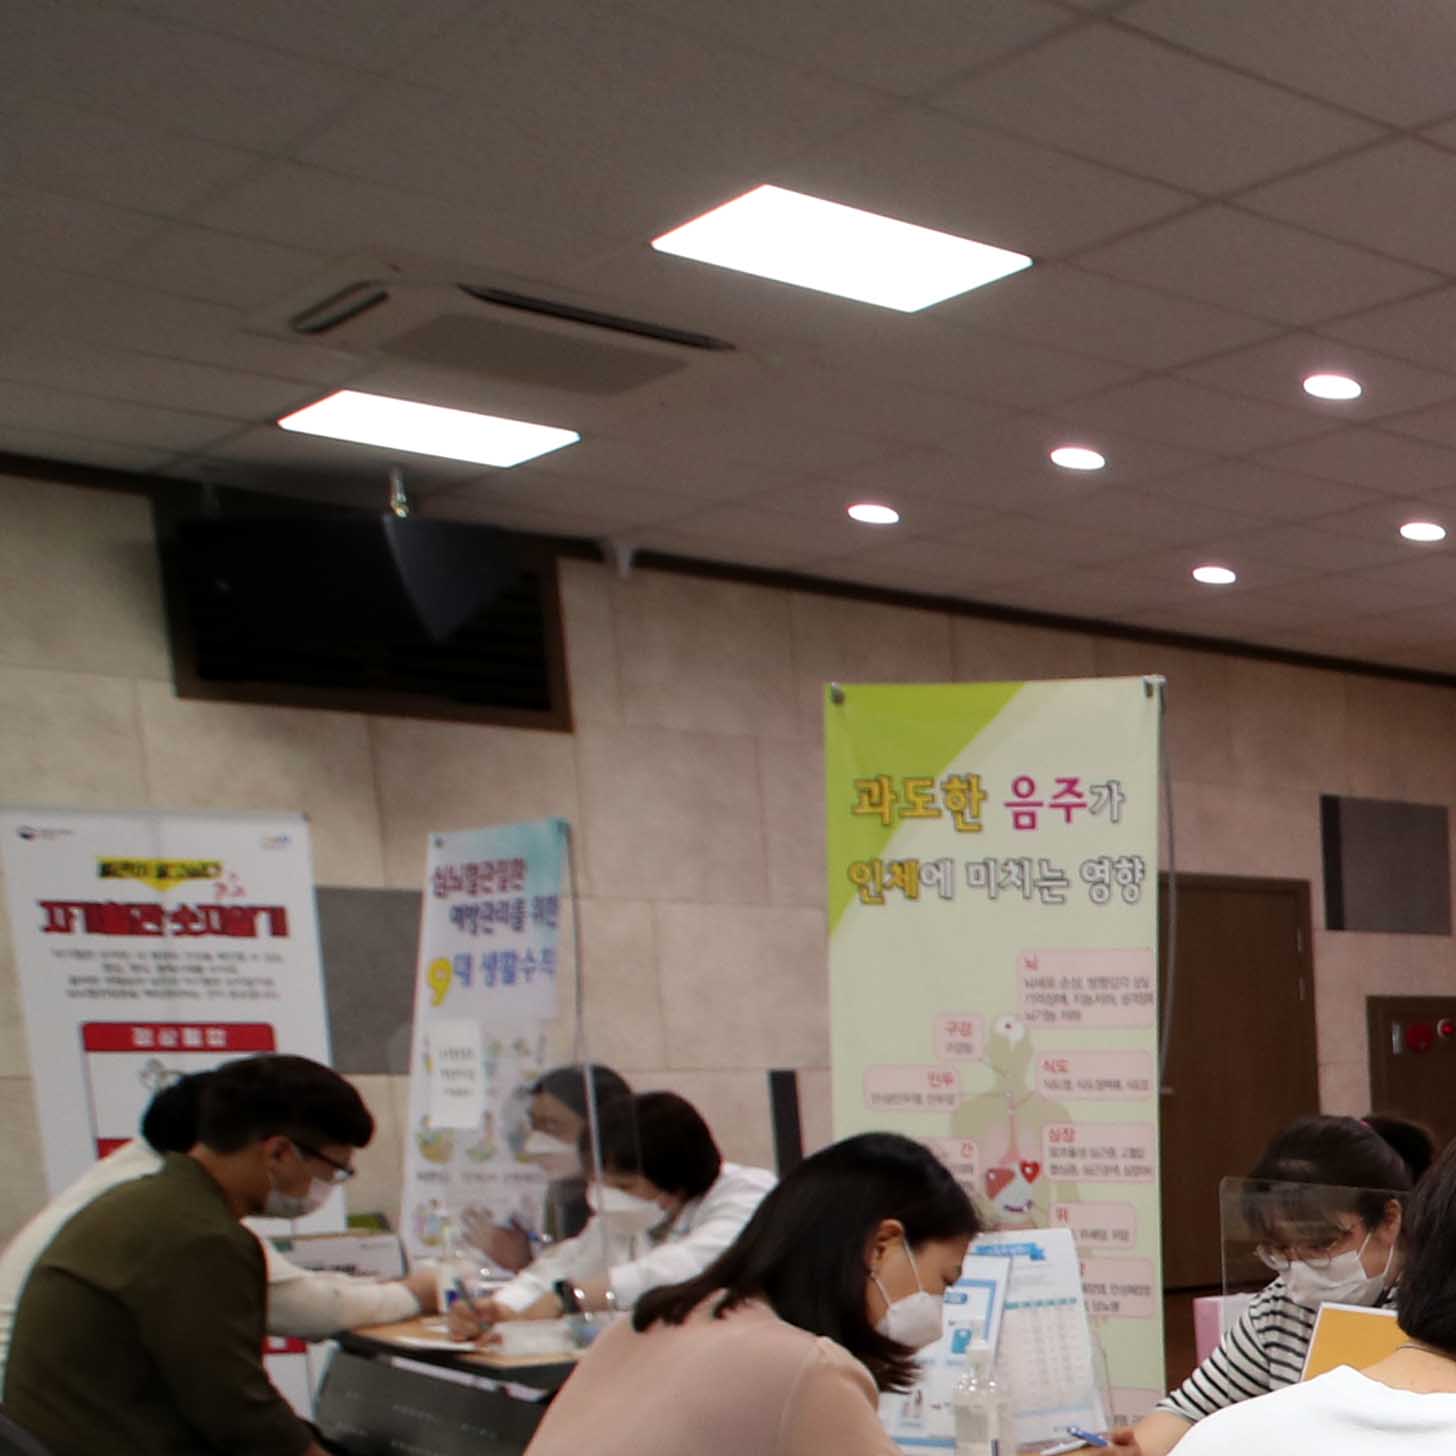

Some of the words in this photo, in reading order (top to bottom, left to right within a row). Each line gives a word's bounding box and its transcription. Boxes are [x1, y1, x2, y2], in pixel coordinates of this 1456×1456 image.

[851, 773, 988, 832] 과도한
[1004, 775, 1128, 830] 음주가
[848, 857, 954, 905] 인체에
[965, 857, 1070, 905] 미치는
[1080, 855, 1145, 904] 영향
